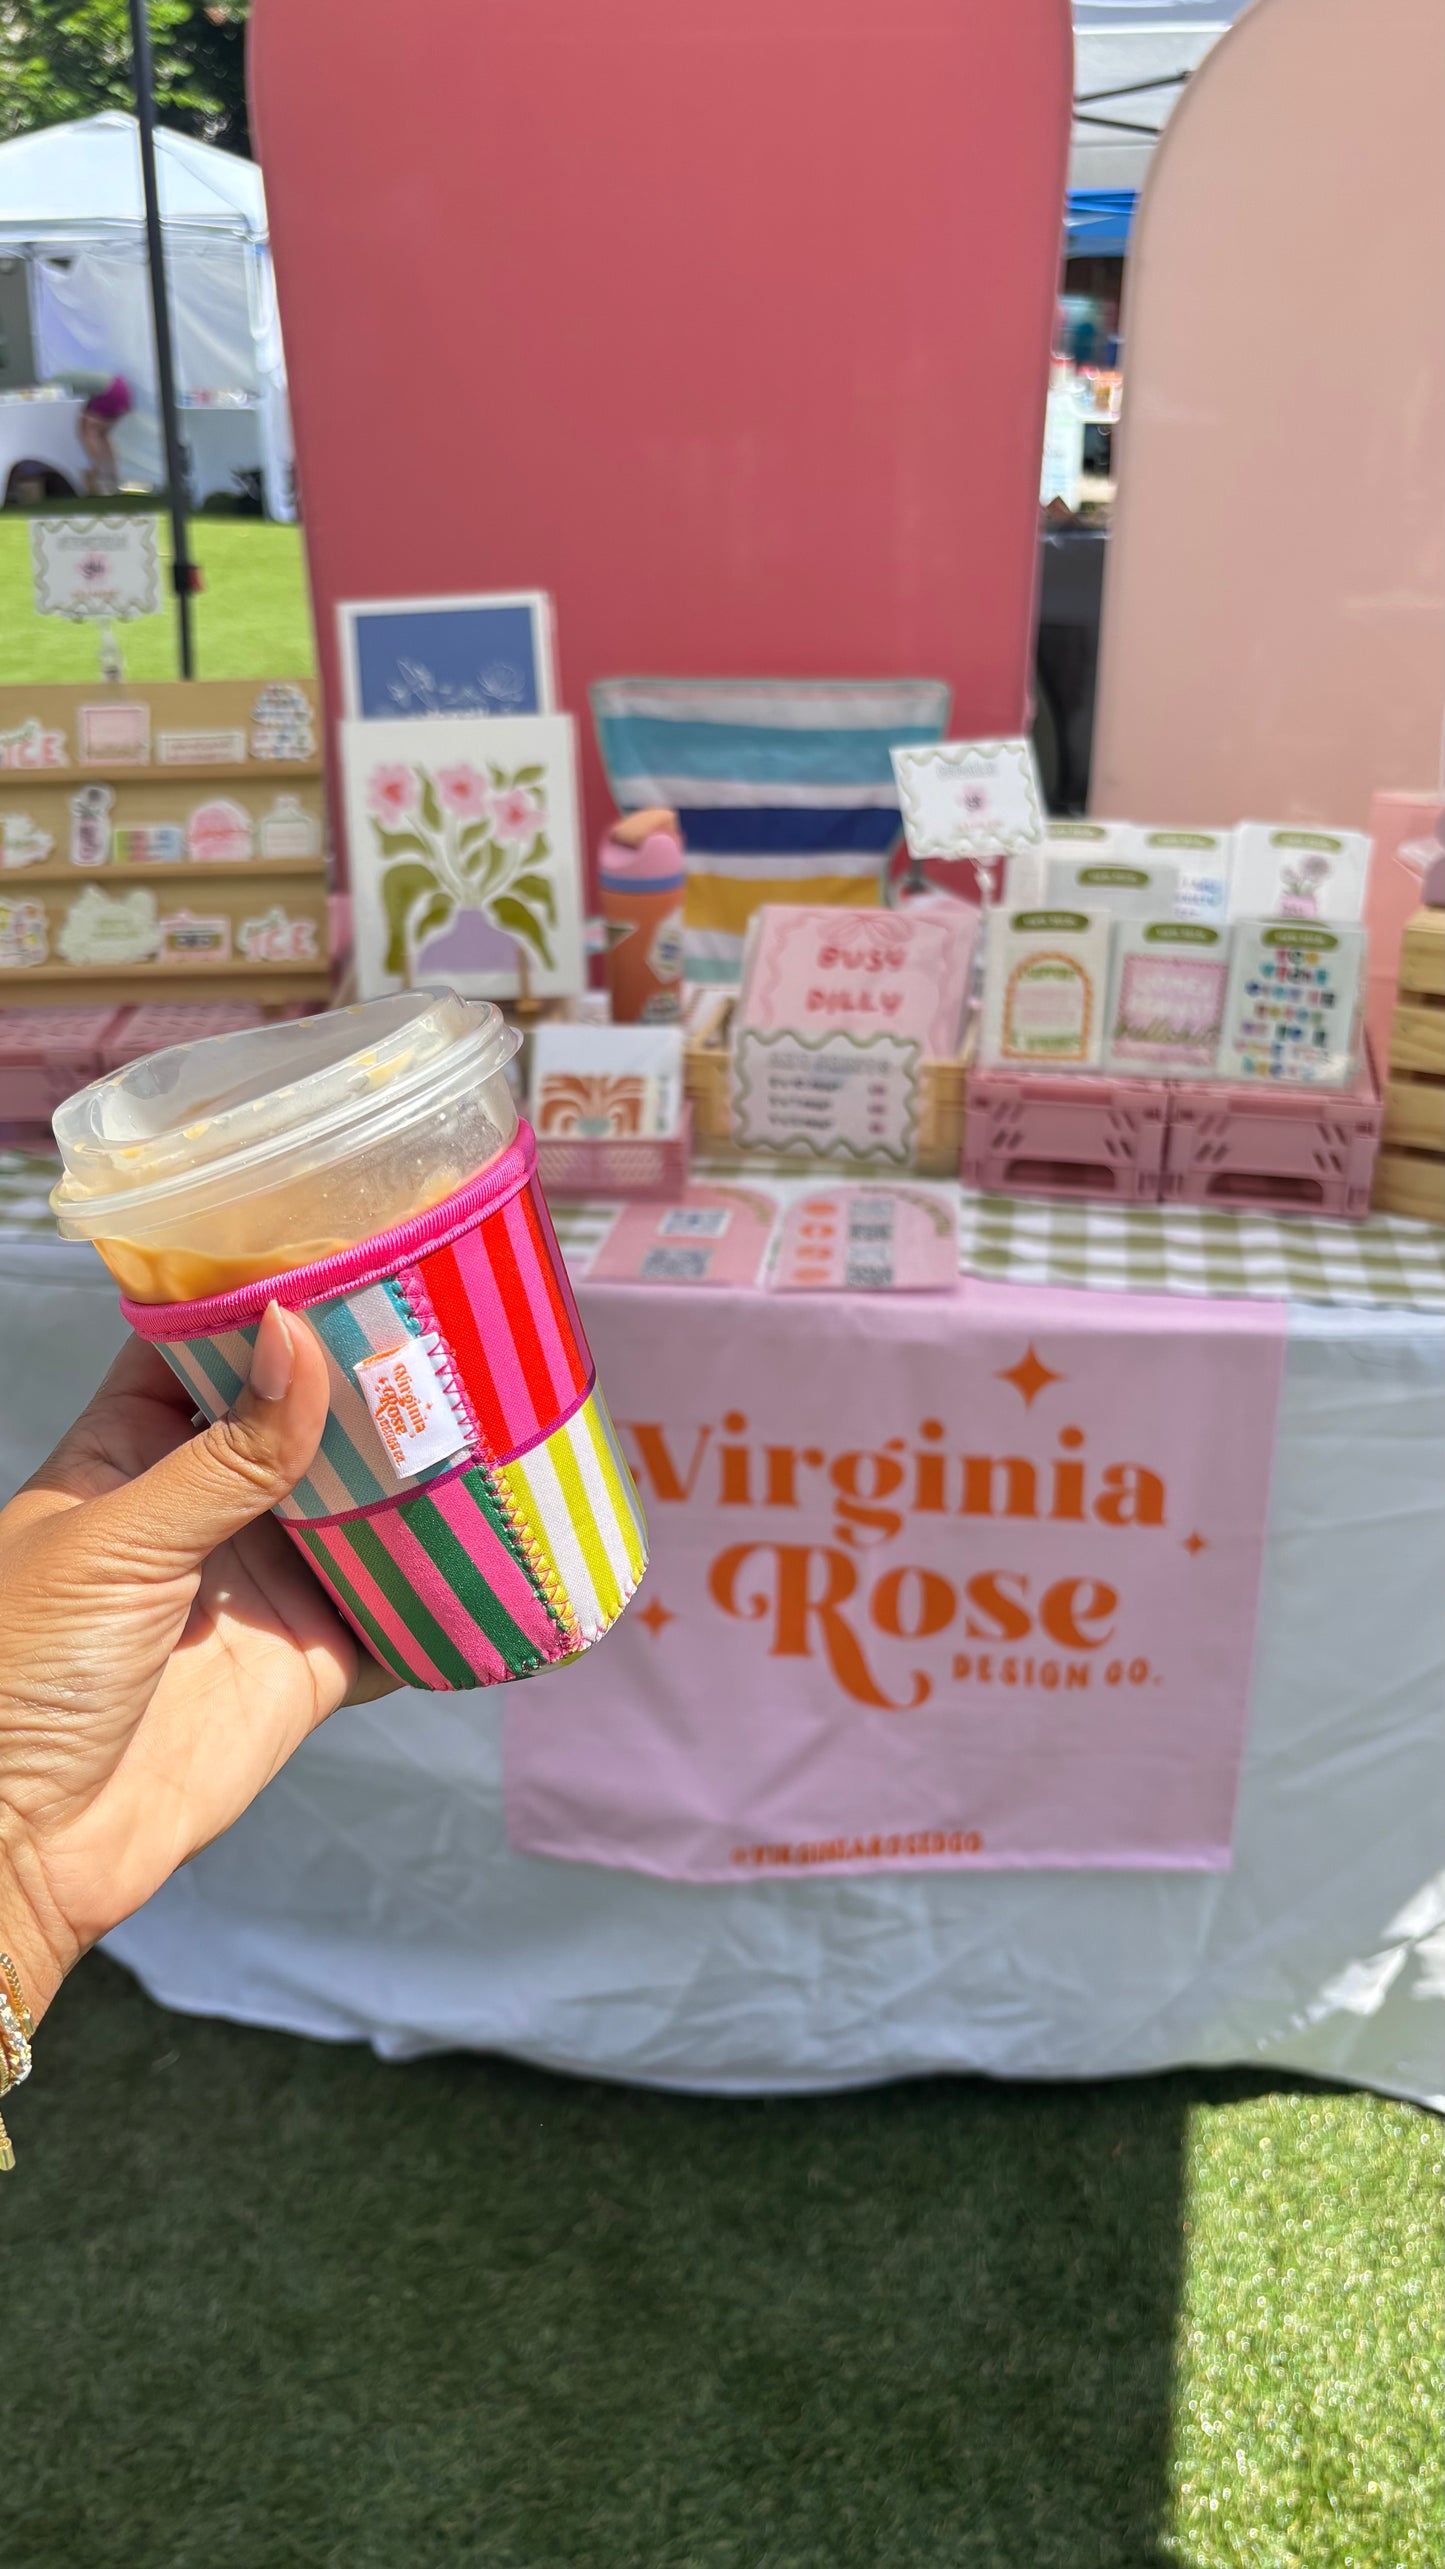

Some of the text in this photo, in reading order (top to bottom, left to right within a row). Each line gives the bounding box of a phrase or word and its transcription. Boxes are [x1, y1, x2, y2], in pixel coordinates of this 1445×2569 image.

[374, 1385, 408, 1436] Rose
[393, 1363, 427, 1434] Virginia
[379, 1415, 402, 1451] DESIGN
[614, 1409, 1167, 1548] Virginia
[708, 1540, 1119, 1712] Rose
[952, 1652, 1091, 1690] DESIGN
